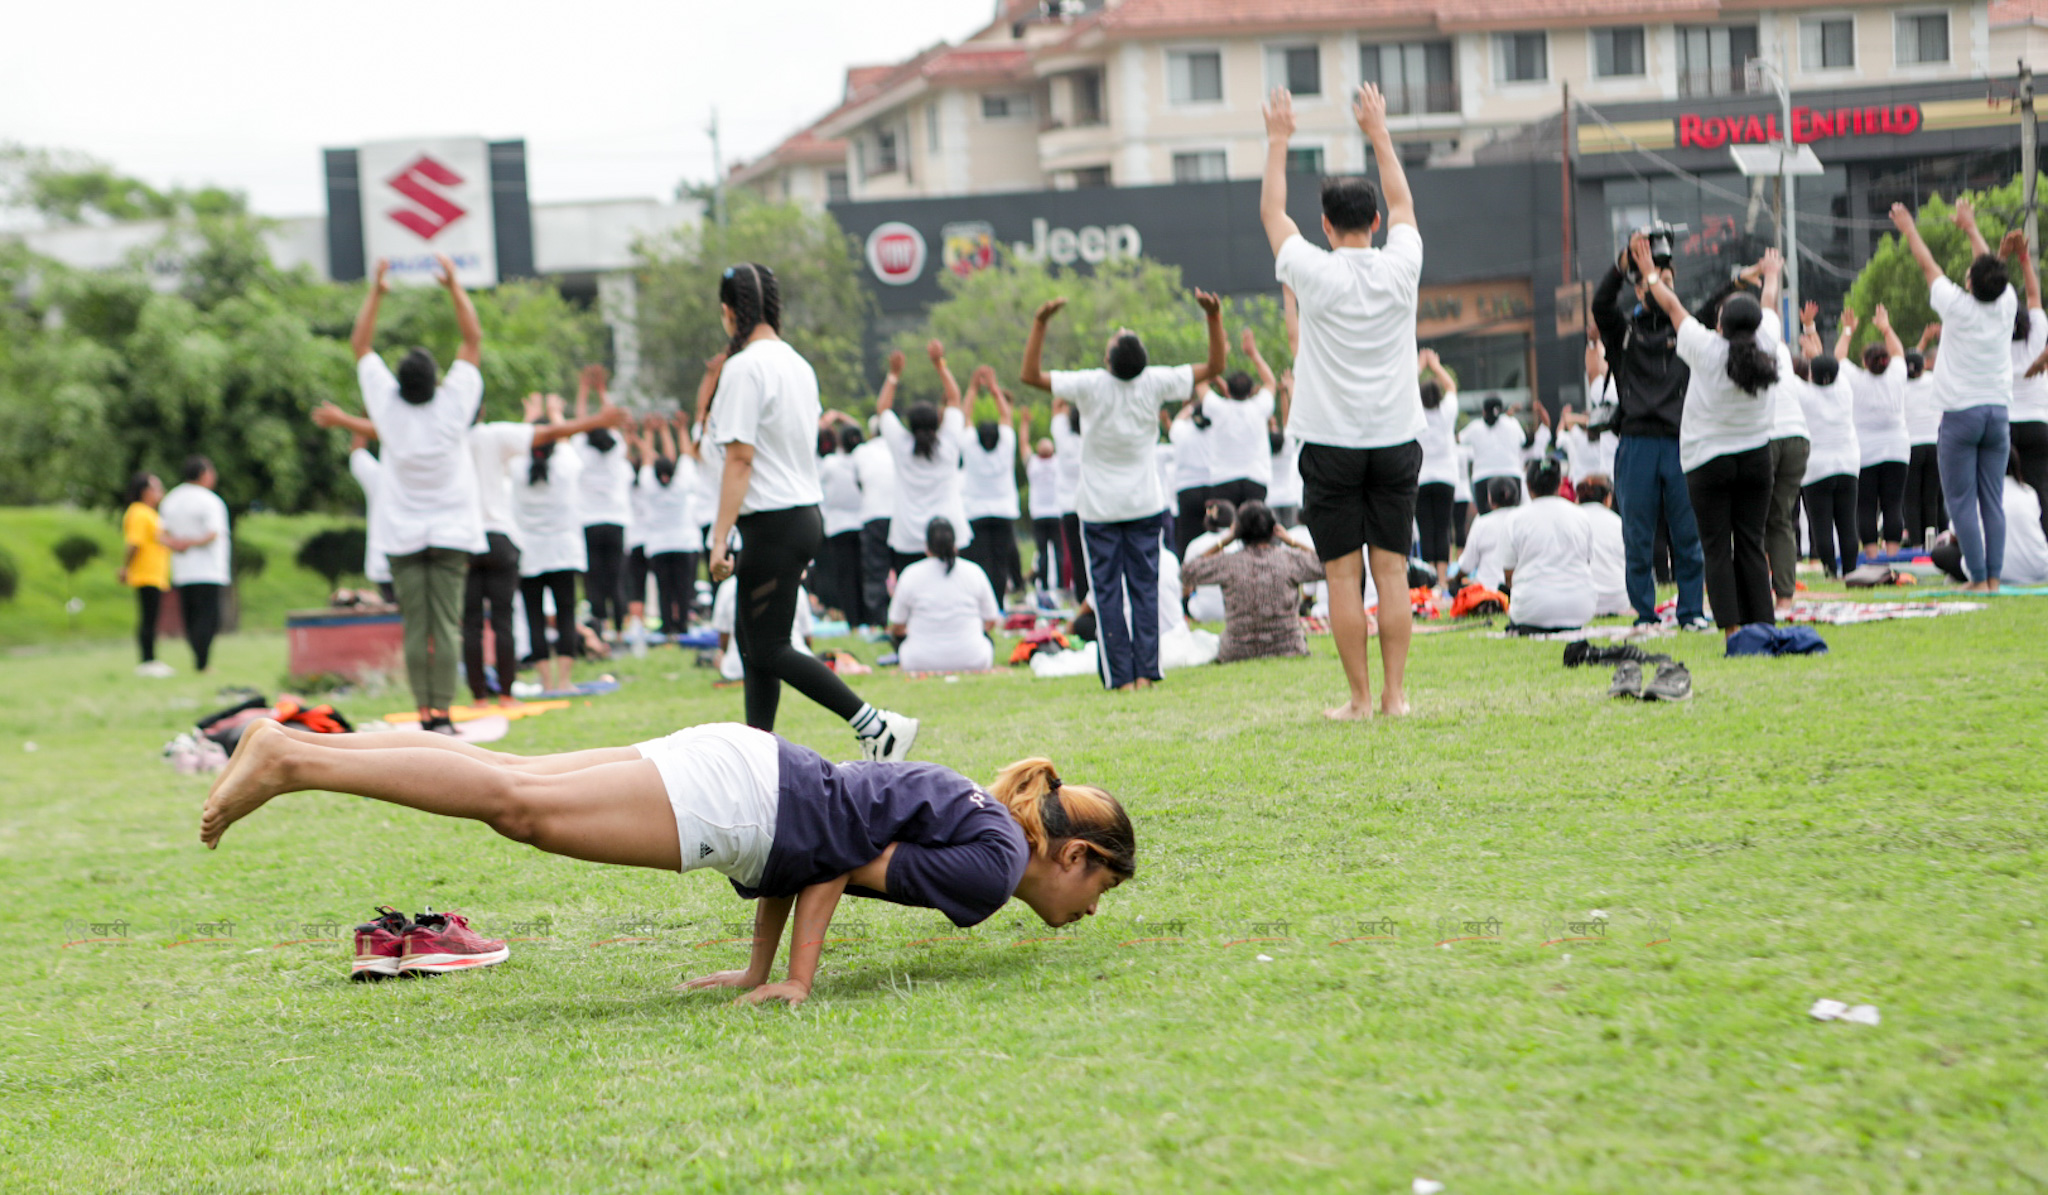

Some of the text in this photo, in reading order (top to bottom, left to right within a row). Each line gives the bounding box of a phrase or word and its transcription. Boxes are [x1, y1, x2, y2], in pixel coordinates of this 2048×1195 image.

[1679, 103, 1921, 149] ROYAL ENFIELD
[1013, 217, 1142, 264] Jeep
